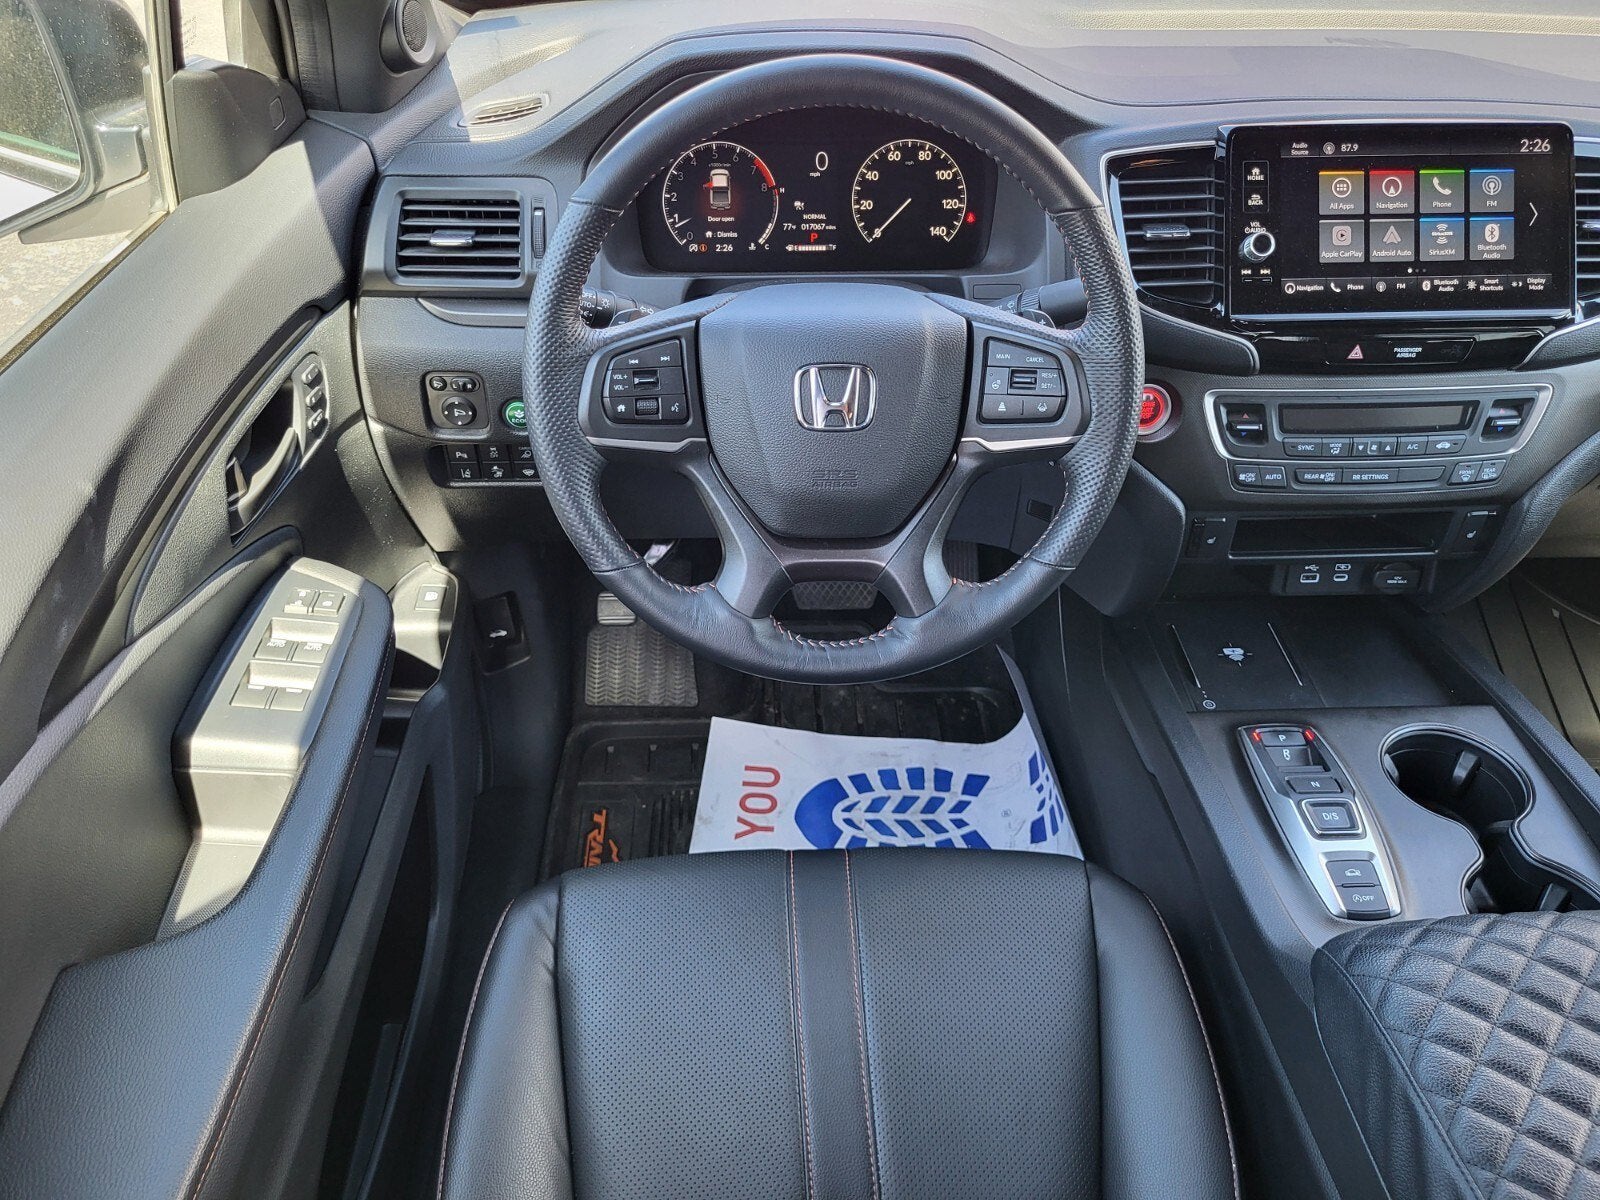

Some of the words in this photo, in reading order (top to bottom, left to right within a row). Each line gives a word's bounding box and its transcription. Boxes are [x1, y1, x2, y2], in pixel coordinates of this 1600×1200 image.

[1341, 144, 1358, 152] 87.9
[1520, 139, 1550, 152] 2:26
[712, 150, 718, 158] 5
[887, 151, 901, 161] 60
[918, 151, 931, 161] 80
[690, 158, 696, 166] 4
[816, 151, 828, 171] 0
[751, 166, 756, 175] 7
[936, 170, 952, 180] 100
[678, 173, 684, 181] 3
[866, 171, 879, 181] 40
[761, 183, 768, 192] 8
[671, 193, 677, 202] 2
[860, 200, 873, 210] 20
[942, 199, 959, 209] 120
[674, 213, 679, 222] 1
[687, 232, 693, 240] 0
[930, 227, 947, 236] 140
[810, 232, 818, 243] P
[715, 244, 733, 252] 2:26
[1296, 284, 1324, 292] Navigation
[580, 300, 592, 308] UTO
[1279, 734, 1286, 742] P
[1283, 749, 1290, 757] R
[735, 765, 780, 839] YOU
